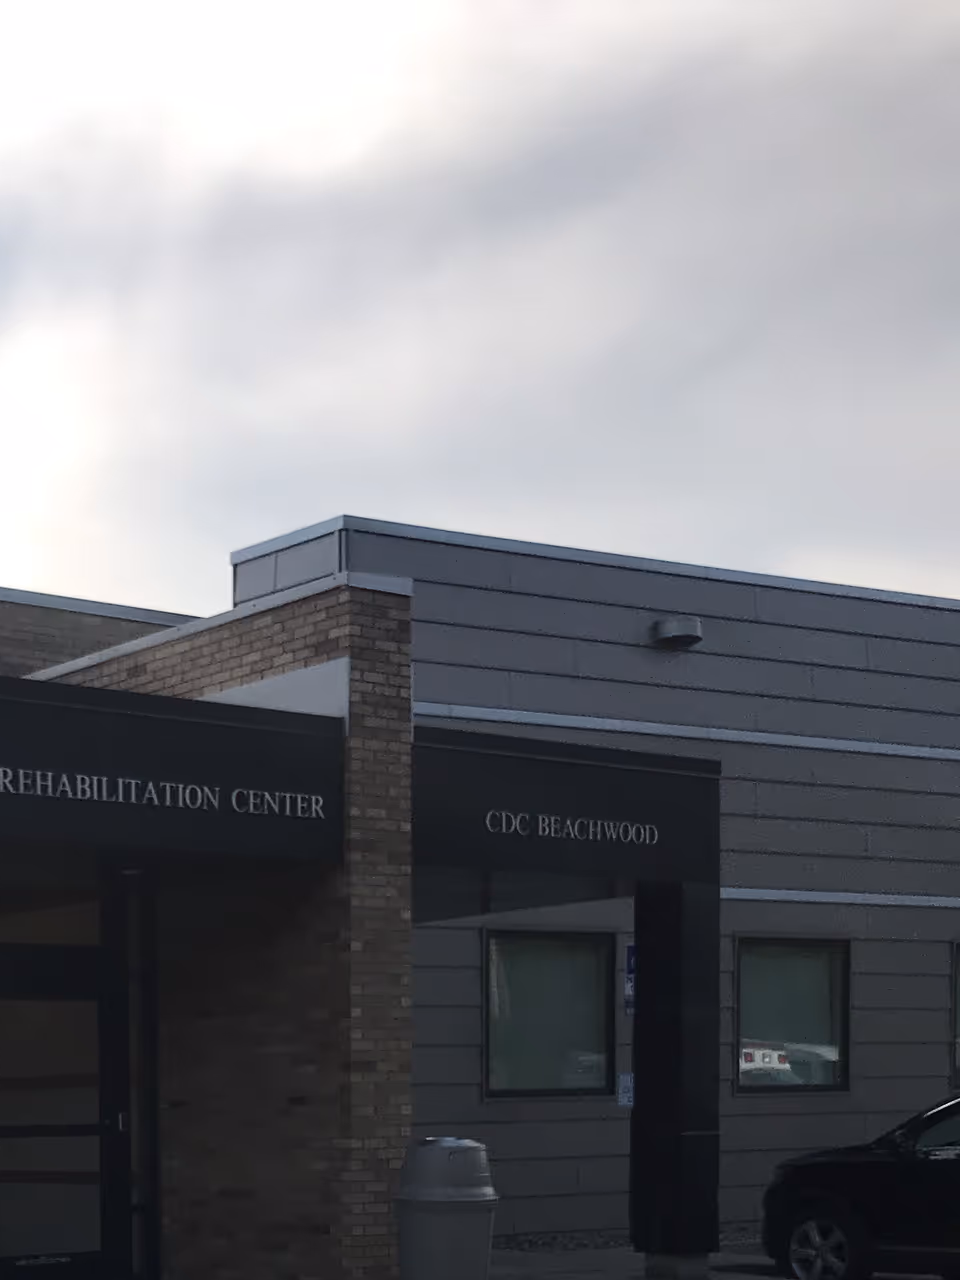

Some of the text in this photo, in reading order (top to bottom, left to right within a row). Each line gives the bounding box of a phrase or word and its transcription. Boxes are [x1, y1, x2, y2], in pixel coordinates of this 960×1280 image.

[232, 788, 326, 819] CENTER
[486, 809, 659, 845] CDC BEACHWOOD
